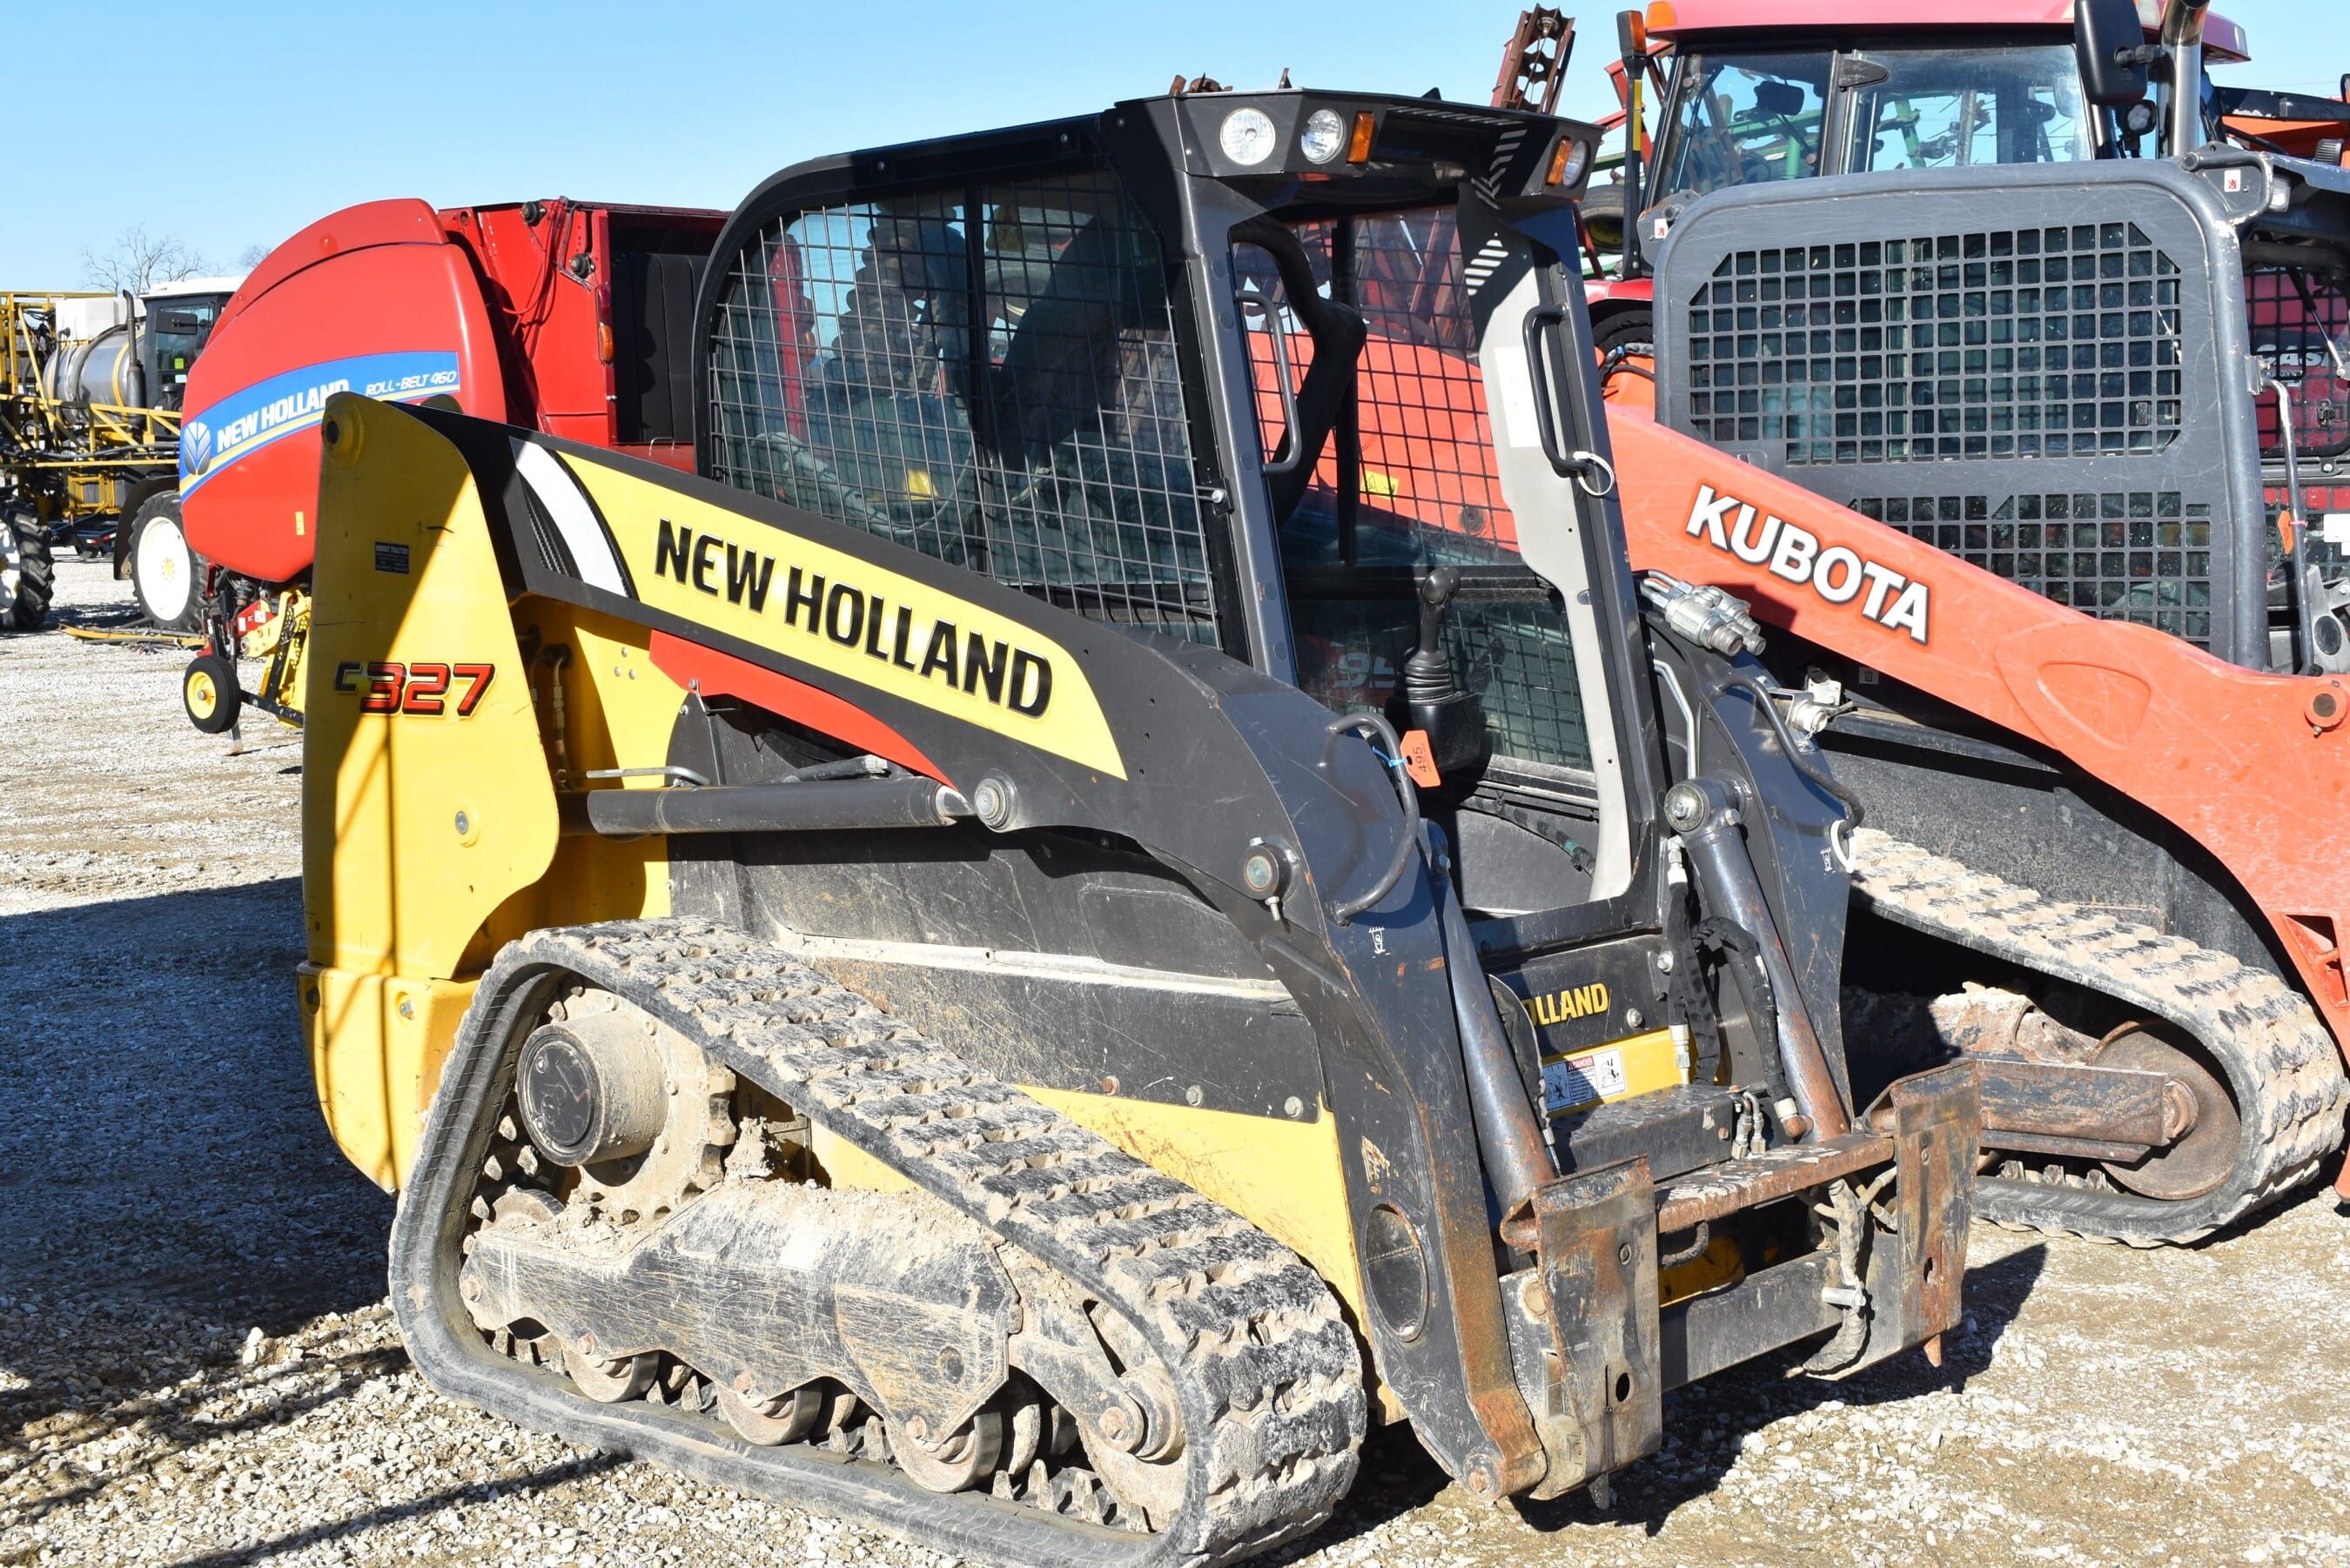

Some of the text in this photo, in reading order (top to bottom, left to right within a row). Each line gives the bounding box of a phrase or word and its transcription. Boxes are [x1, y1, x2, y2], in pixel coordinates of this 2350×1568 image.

[366, 371, 457, 397] ROLL-BELT 460
[218, 411, 258, 452] NEW
[1686, 484, 1929, 645] KUBOTA
[655, 517, 1053, 720] NEW HOLLAND
[335, 661, 497, 717] C327
[1413, 747, 1428, 773] 495
